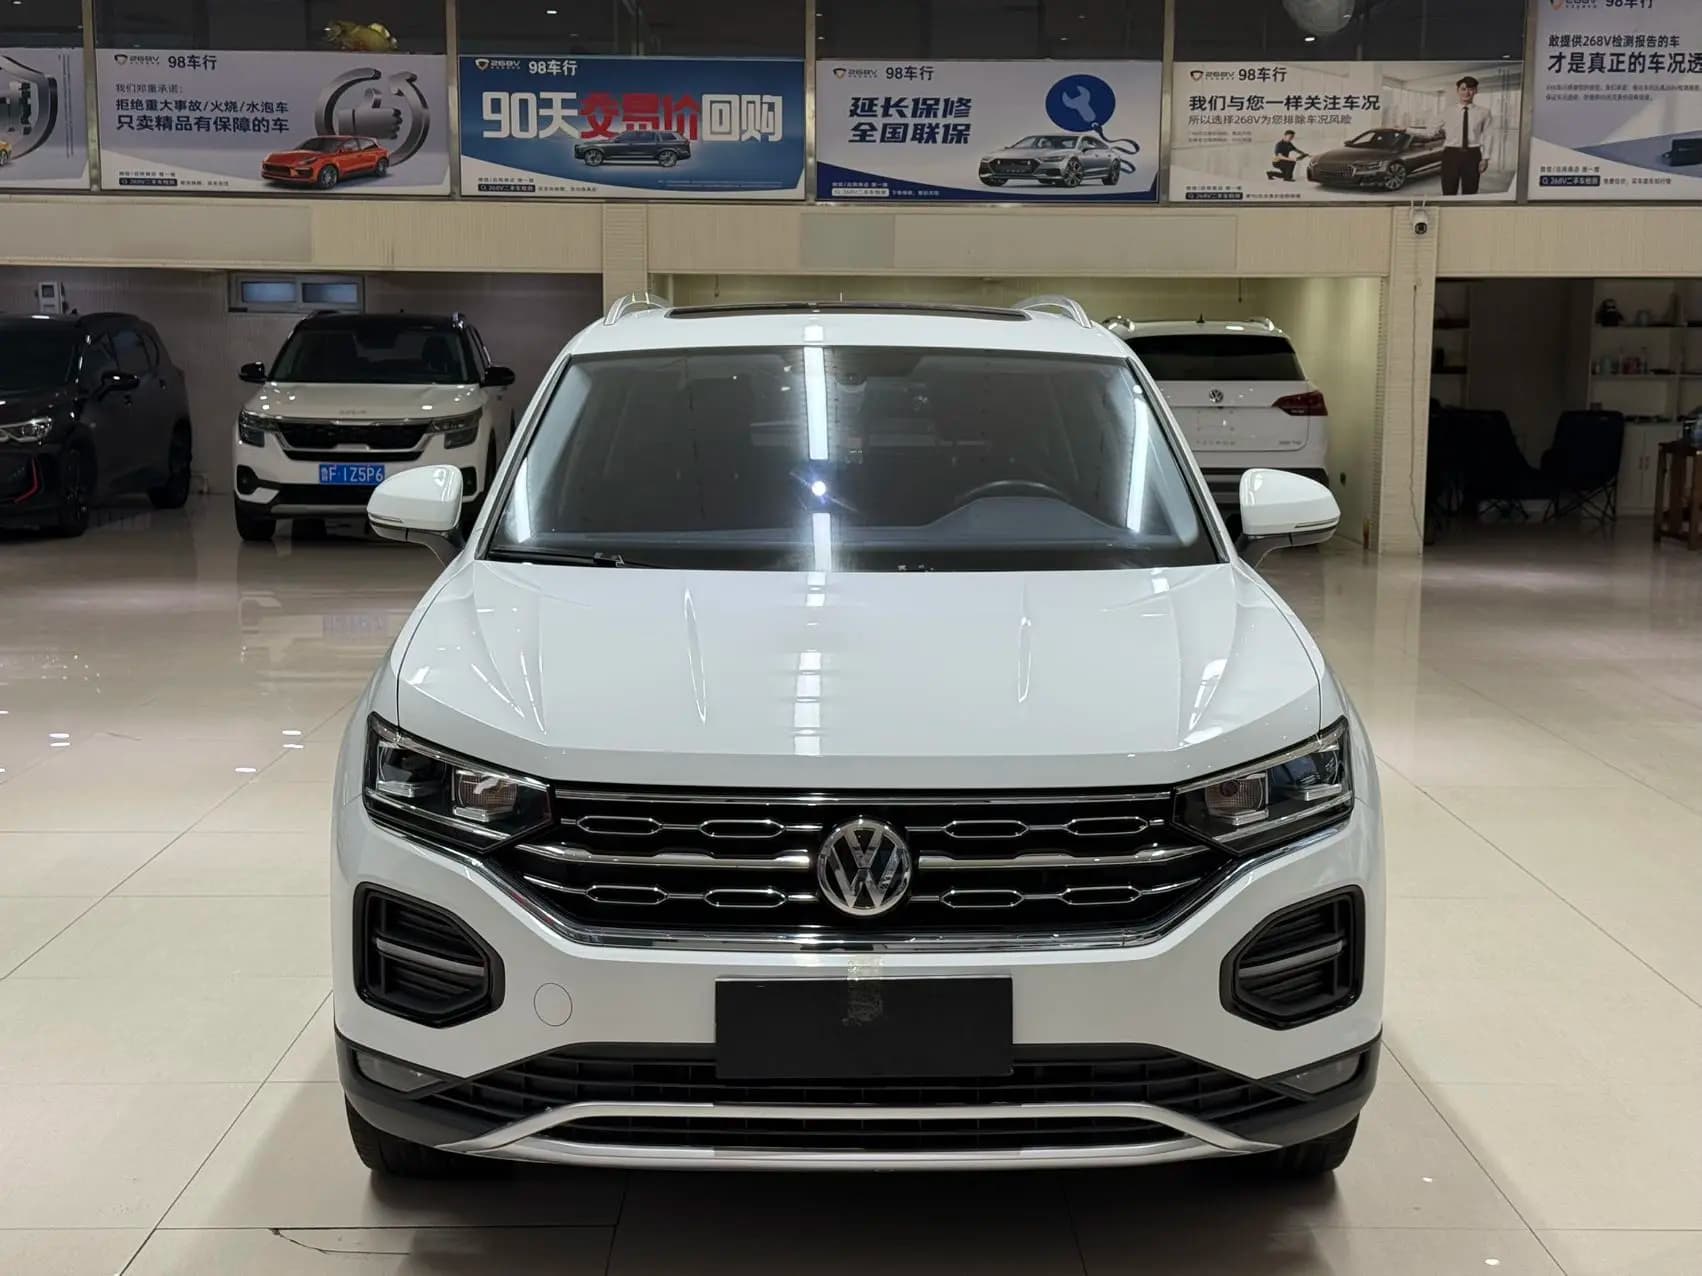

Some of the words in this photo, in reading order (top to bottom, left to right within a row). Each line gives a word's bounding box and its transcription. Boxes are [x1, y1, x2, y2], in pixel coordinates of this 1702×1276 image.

[1548, 34, 1680, 48] 敢提供268V检测报告的车
[168, 55, 217, 70] 98车行
[528, 59, 578, 76] 98车行
[885, 65, 934, 80] 98车行
[1238, 66, 1287, 82] 98车行
[115, 99, 289, 113] 拒绝重大事故/火烧/水泡车
[848, 97, 972, 118] 延长保修
[1188, 95, 1381, 111] 我们与您一样关注车况
[116, 115, 290, 133] 只卖精品有保障的车
[482, 91, 783, 142] 90天交易价回购
[1188, 114, 1352, 125] 所以选择268V为您排除车况风险
[848, 122, 972, 144] 全国联保
